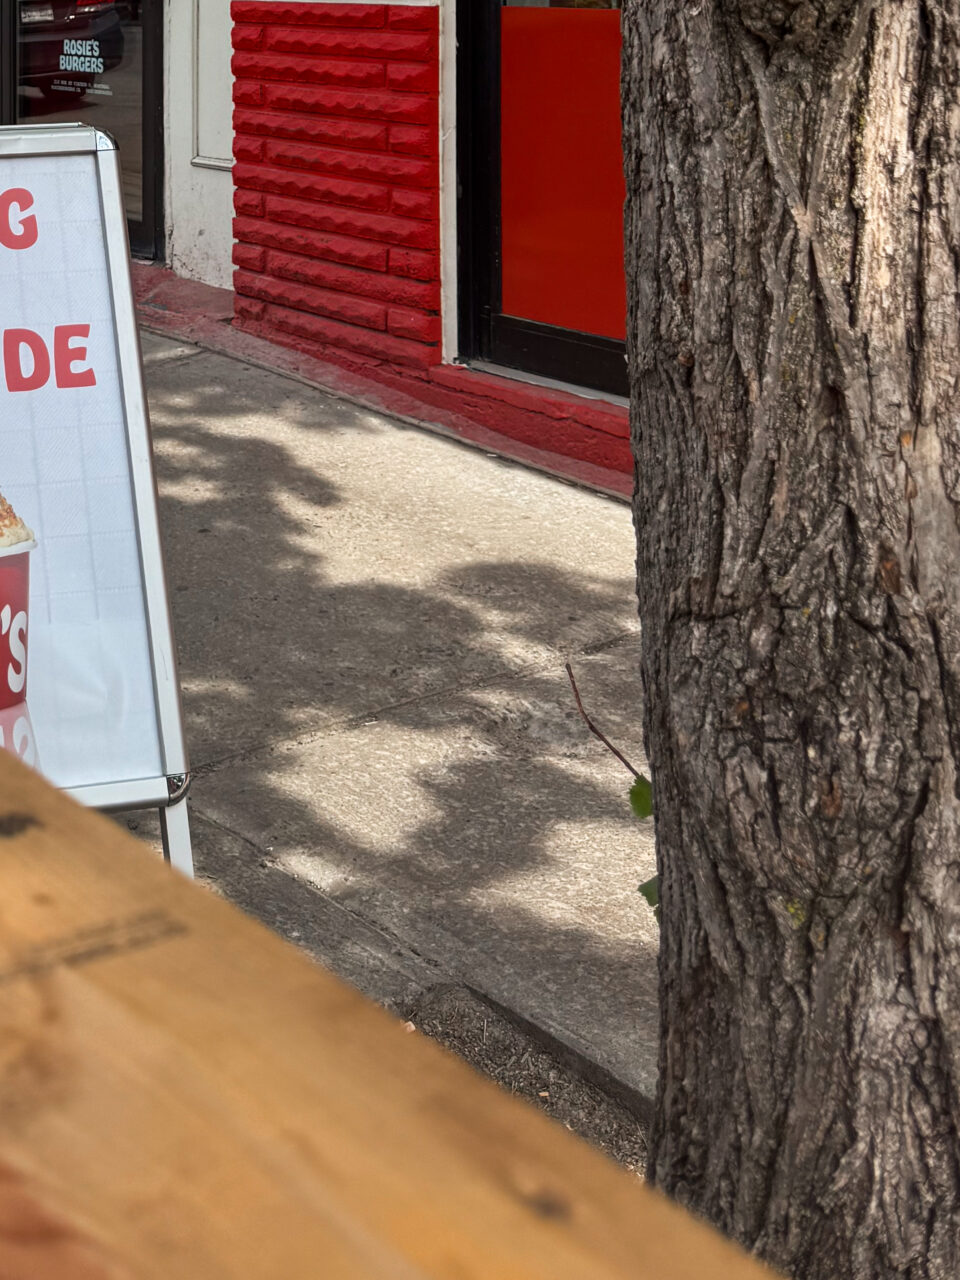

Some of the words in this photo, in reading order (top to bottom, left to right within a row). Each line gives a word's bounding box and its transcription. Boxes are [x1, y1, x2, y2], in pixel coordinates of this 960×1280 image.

[63, 39, 100, 57] ROSIE'S
[59, 55, 104, 74] BURGERS
[2, 323, 96, 393] DE
